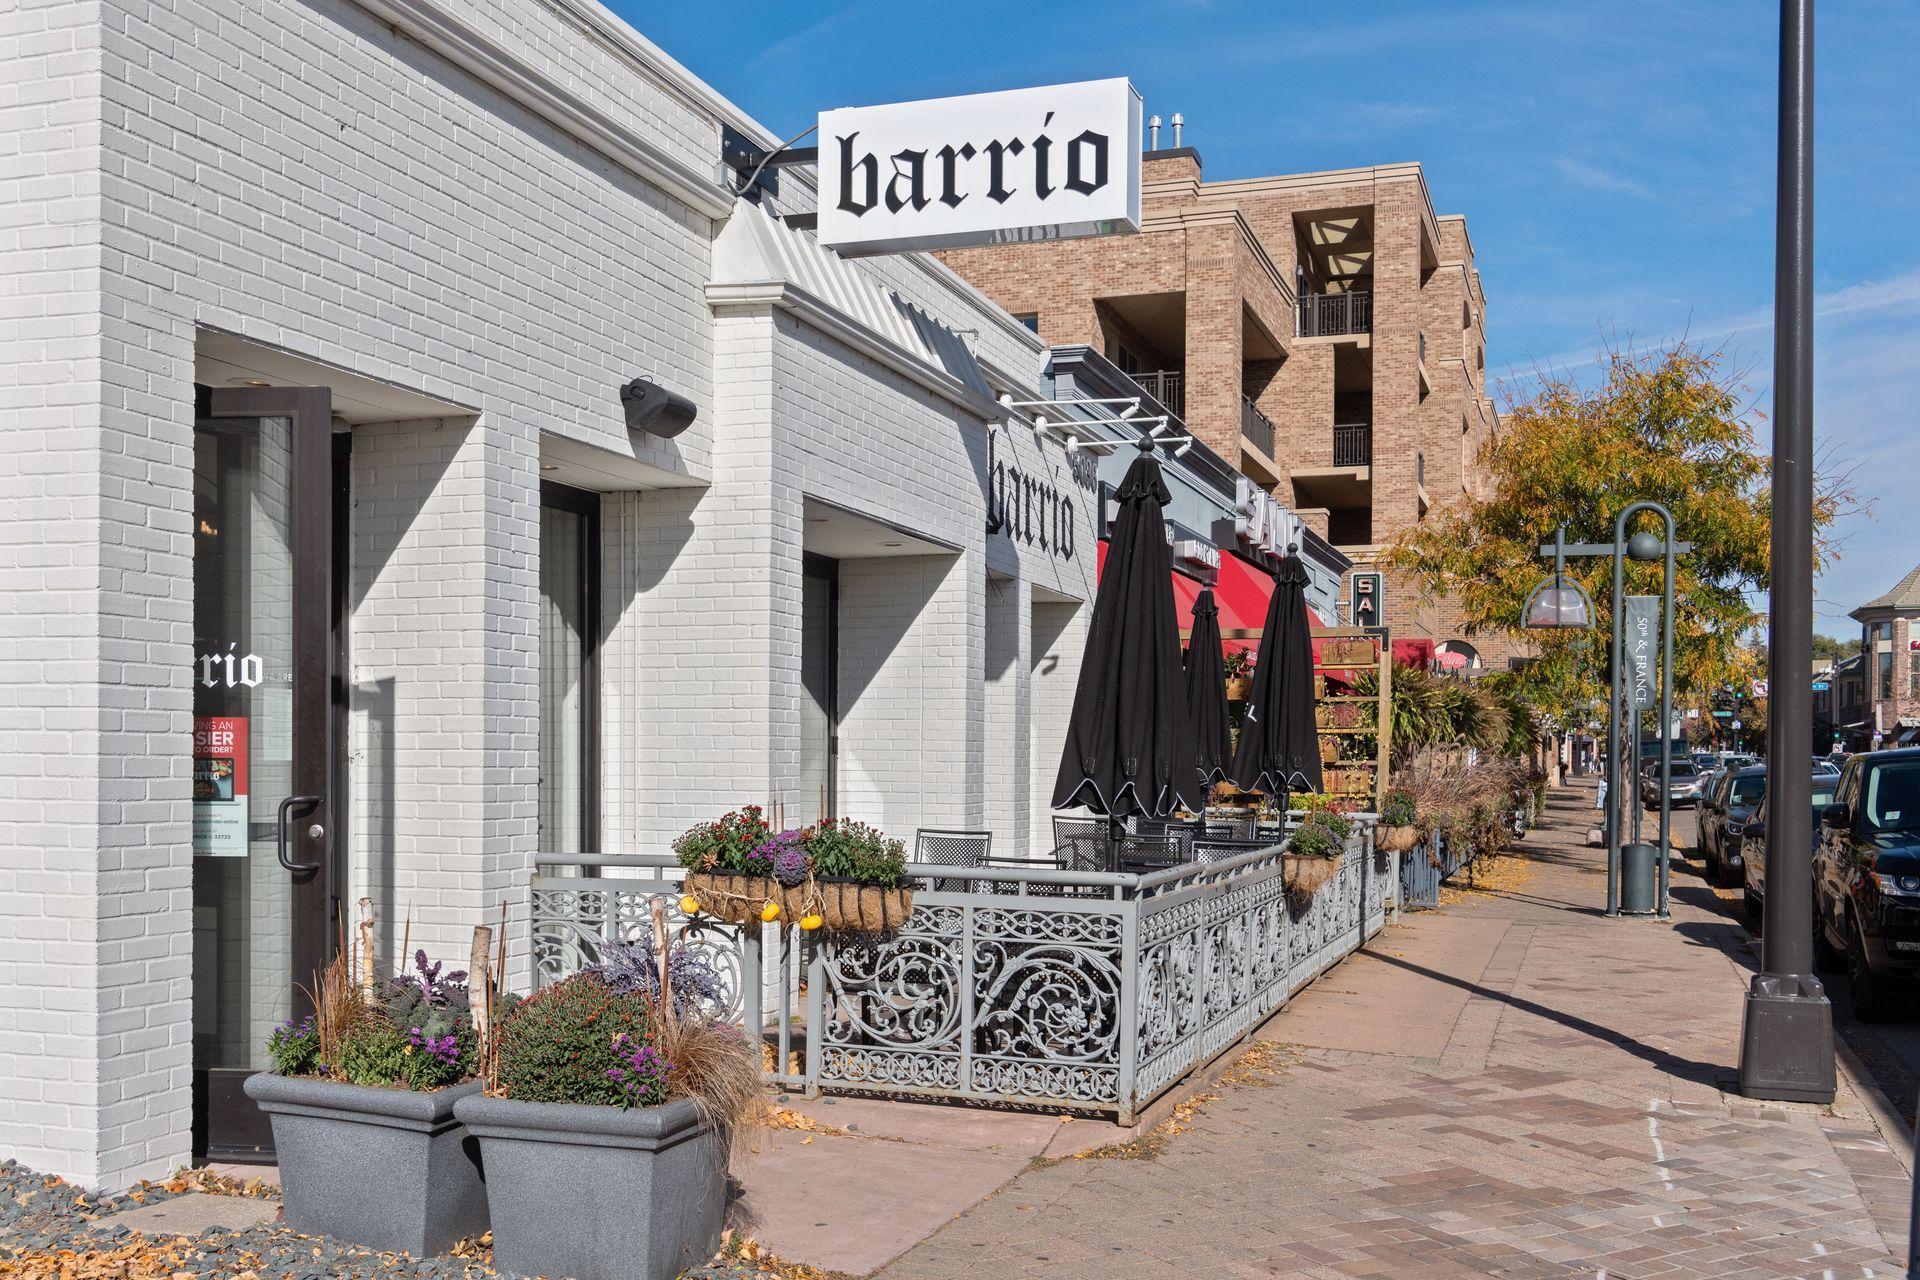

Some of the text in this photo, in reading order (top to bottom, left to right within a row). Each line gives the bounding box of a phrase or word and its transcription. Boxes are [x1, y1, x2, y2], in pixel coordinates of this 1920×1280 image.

[194, 642, 263, 688] río
[1636, 617, 1649, 704] 50th & FRANCE
[196, 731, 234, 746] SIER
[218, 721, 233, 730] AN
